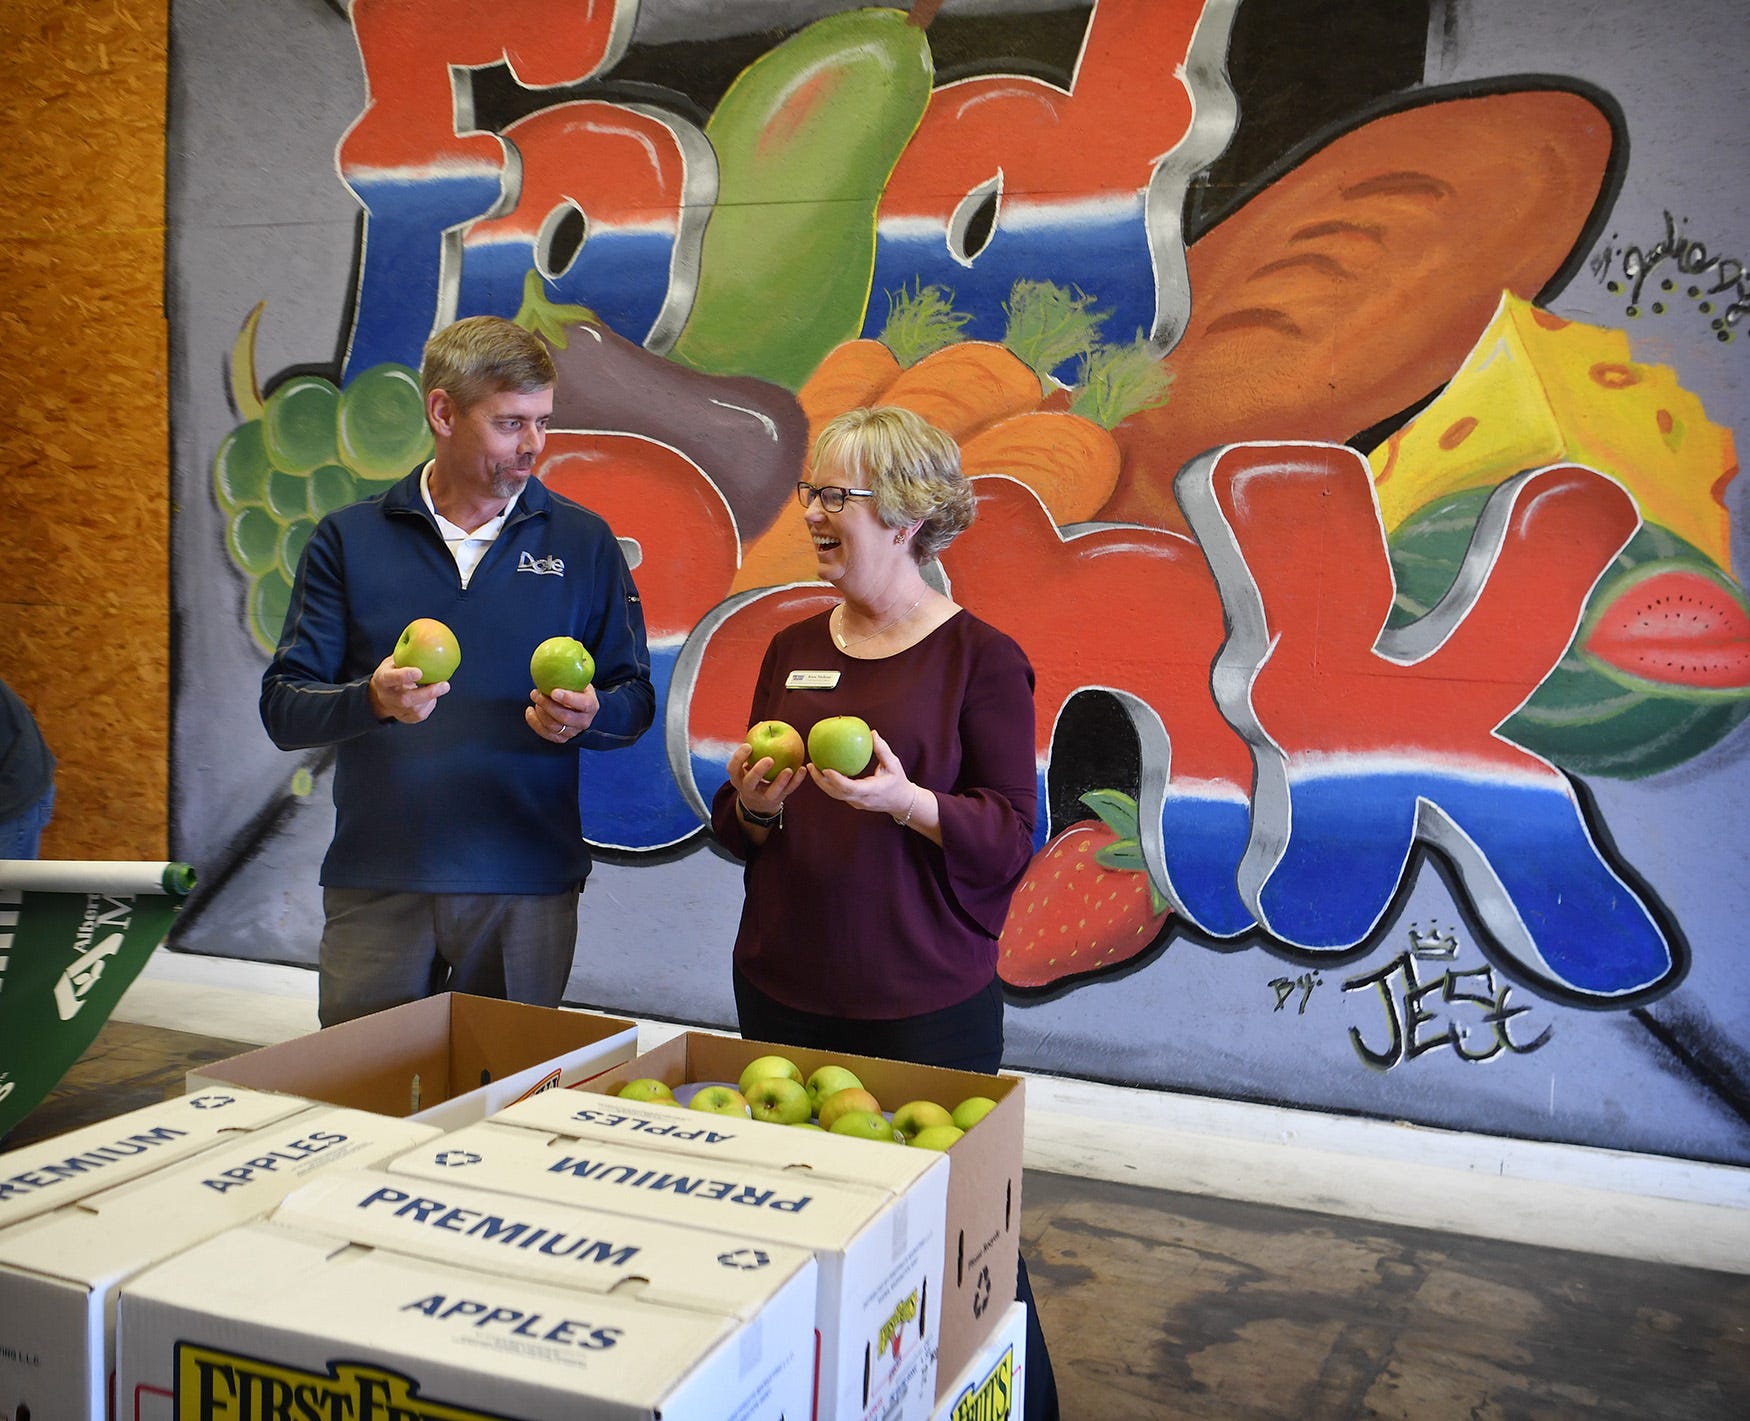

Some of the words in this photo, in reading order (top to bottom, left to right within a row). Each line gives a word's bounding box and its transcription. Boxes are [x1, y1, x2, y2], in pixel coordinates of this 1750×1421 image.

[517, 551, 565, 577] Dole
[570, 1109, 737, 1143] APPLES
[202, 1131, 348, 1194] APPLES
[547, 1156, 814, 1212] PREMIUM
[357, 1187, 642, 1266] PREMIUM
[400, 1295, 625, 1350] APPLES
